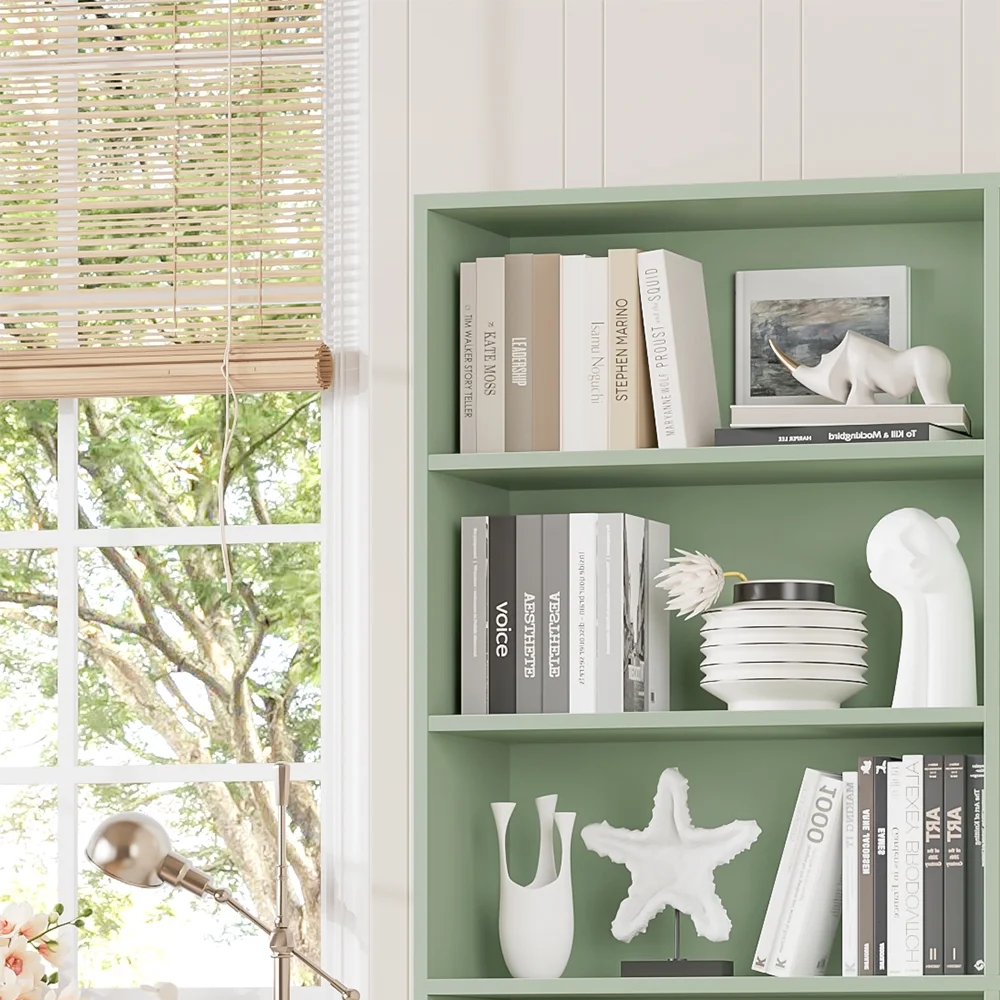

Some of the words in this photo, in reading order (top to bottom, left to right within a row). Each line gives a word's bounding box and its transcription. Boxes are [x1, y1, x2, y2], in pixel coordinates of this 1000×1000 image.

[464, 314, 473, 325] TIM
[616, 298, 628, 347] MARINO
[464, 326, 473, 363] WALKER
[484, 332, 496, 362] KATE
[512, 337, 527, 386] LEADERSHIP
[464, 365, 473, 395] STORY
[484, 365, 496, 396] MOSS
[616, 349, 628, 401] STEPHEN
[464, 397, 473, 418] TELLER
[496, 601, 512, 657] voice
[524, 592, 535, 678] AESTHETE
